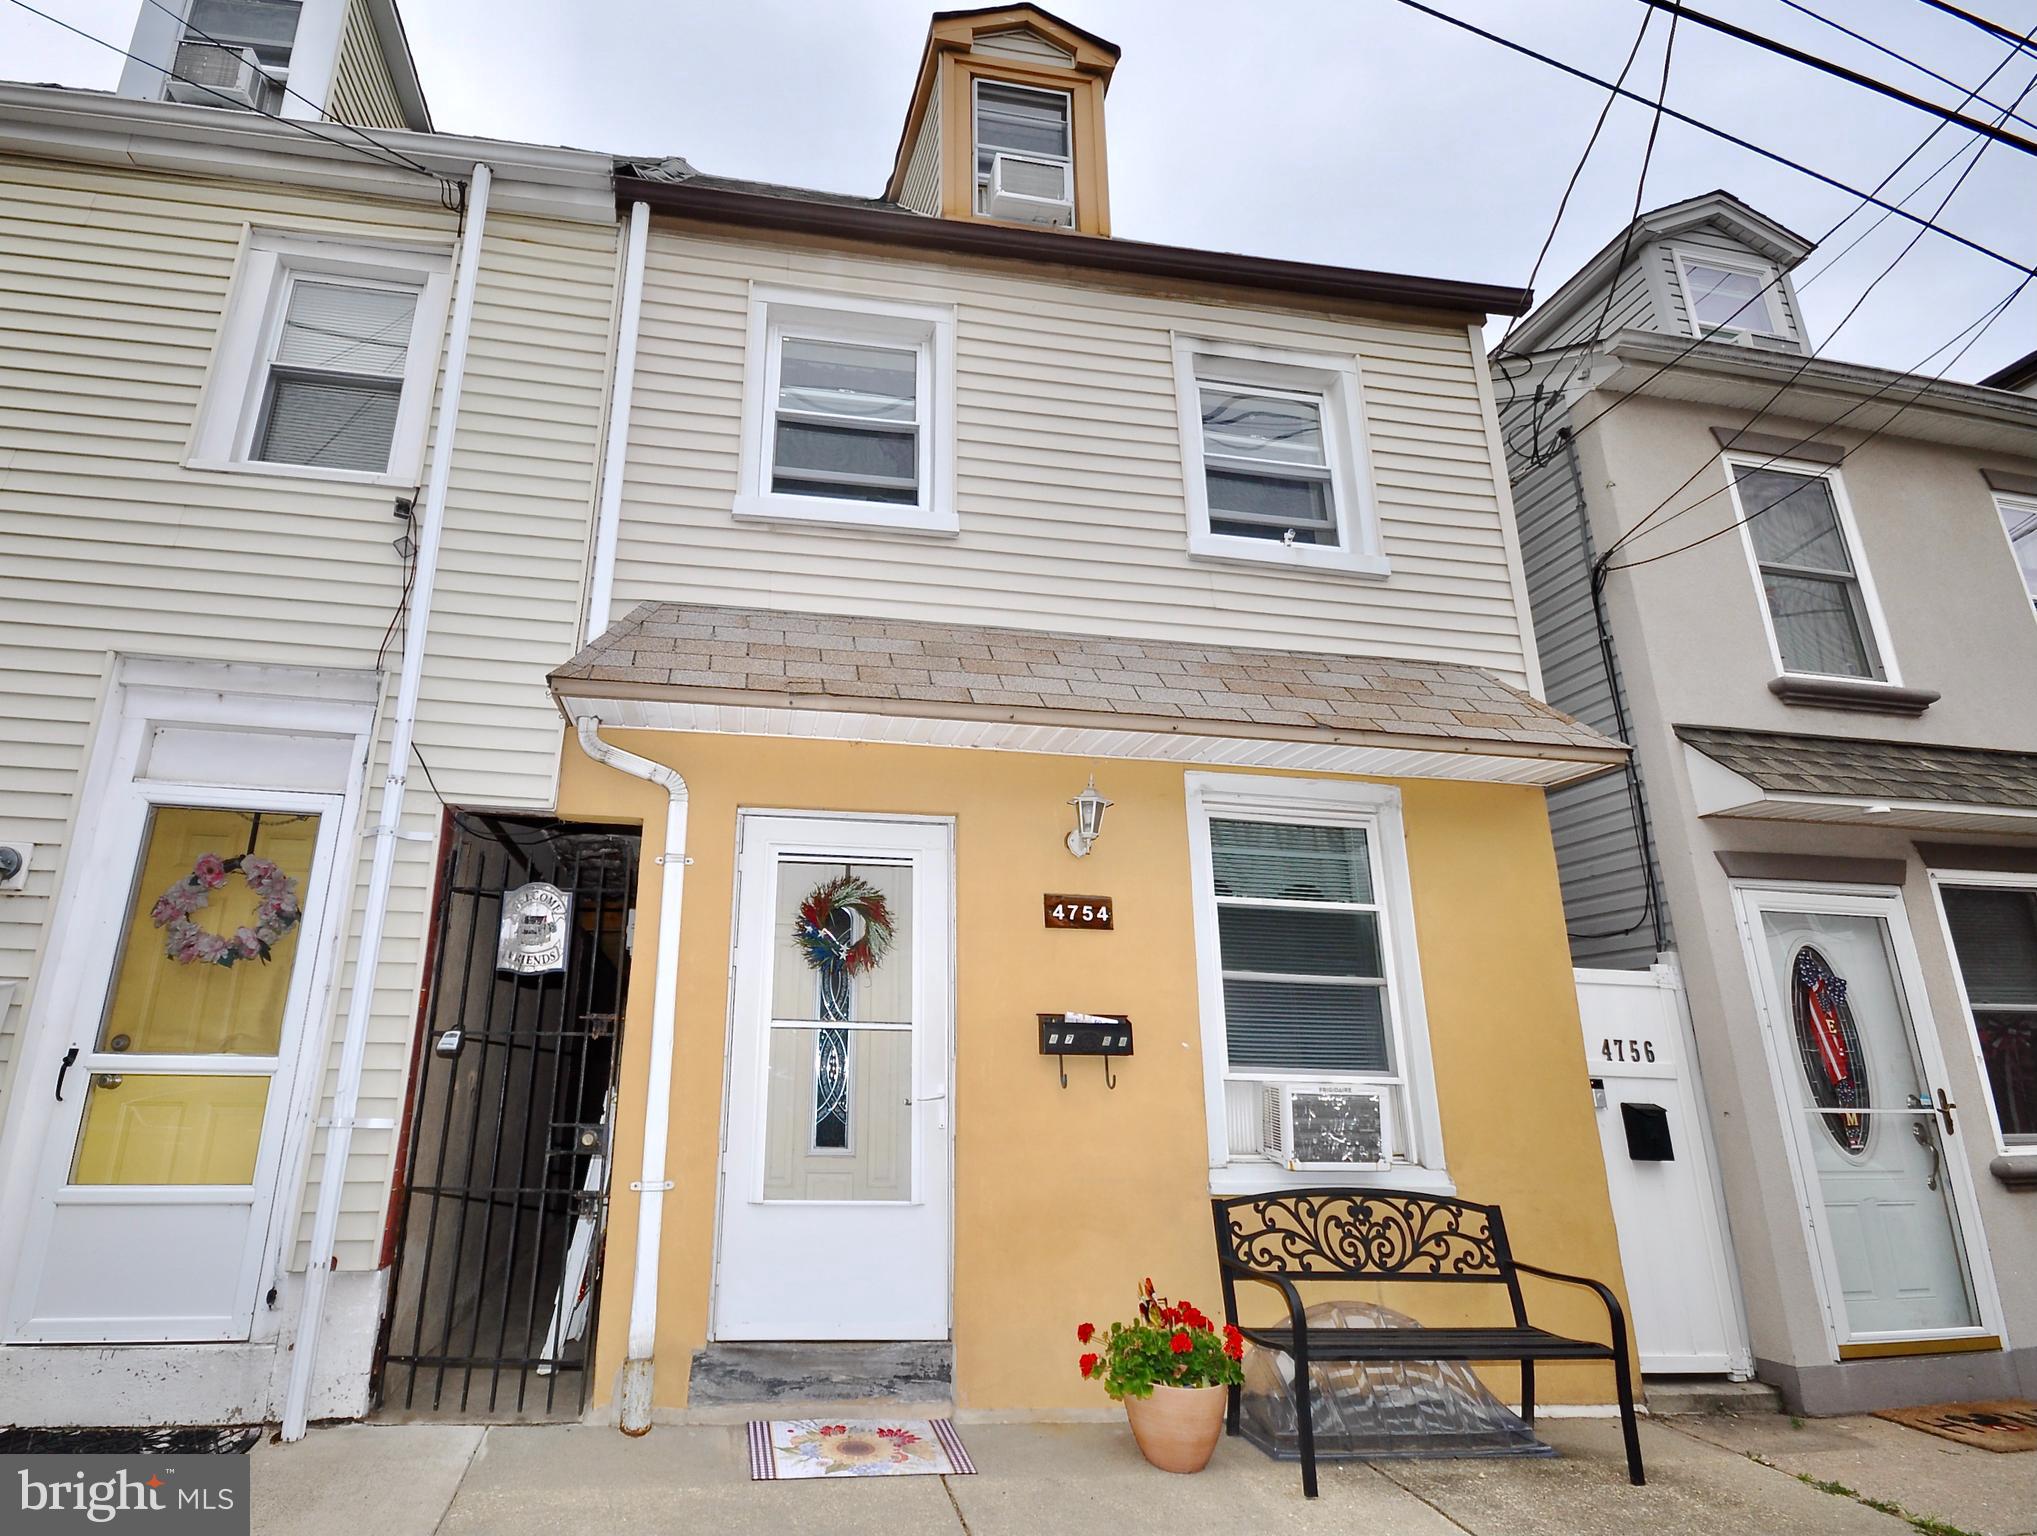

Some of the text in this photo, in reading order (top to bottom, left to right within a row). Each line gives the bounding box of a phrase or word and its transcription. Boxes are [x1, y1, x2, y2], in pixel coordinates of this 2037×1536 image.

[1052, 904, 1109, 921] 4754
[508, 951, 557, 966] FRIENDS
[1601, 1038, 1656, 1063] 4756
